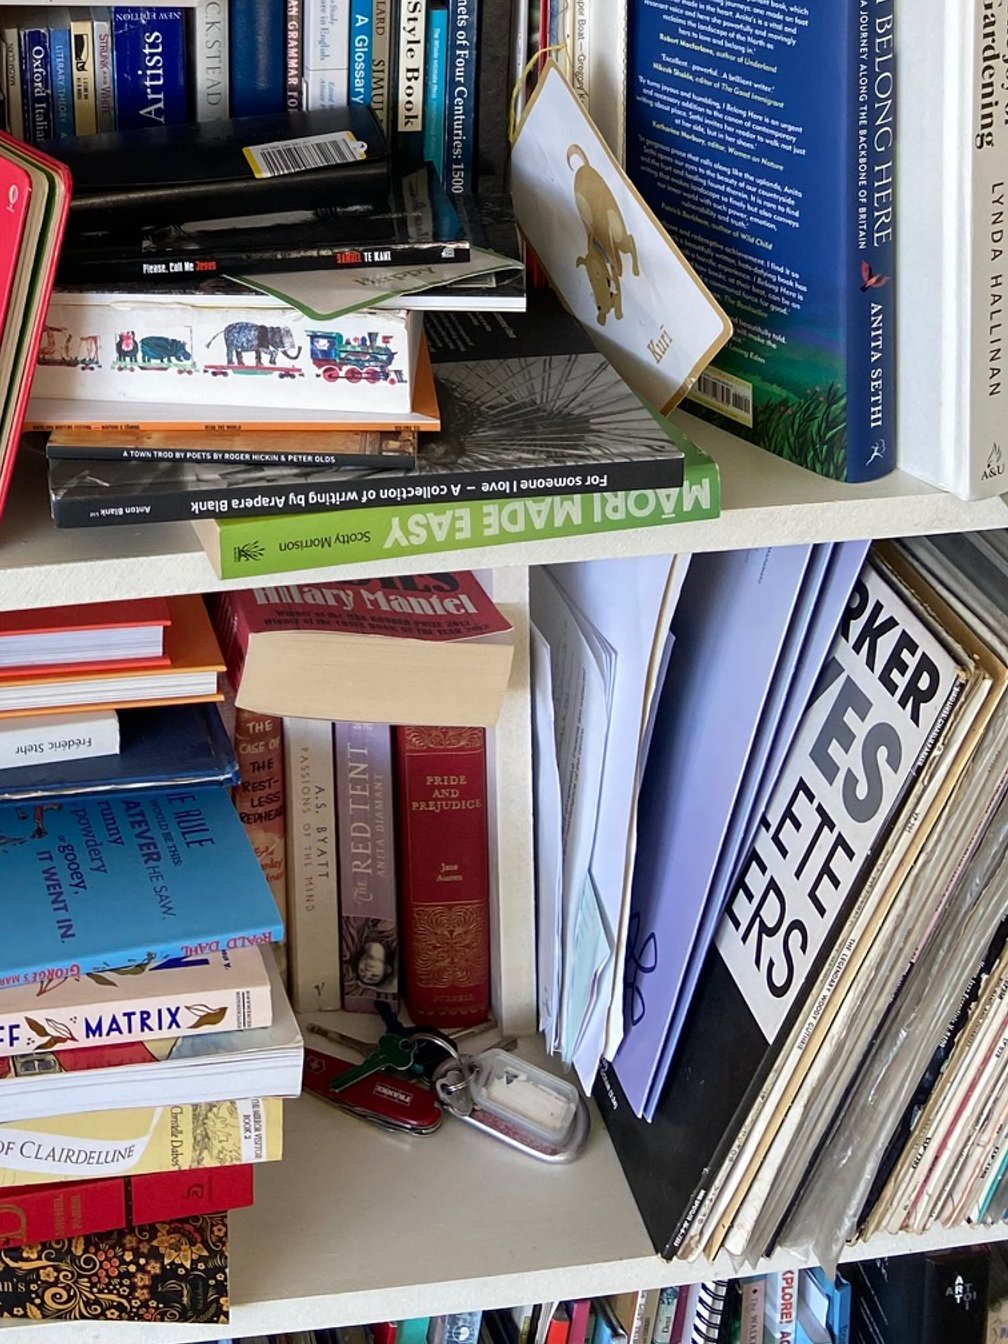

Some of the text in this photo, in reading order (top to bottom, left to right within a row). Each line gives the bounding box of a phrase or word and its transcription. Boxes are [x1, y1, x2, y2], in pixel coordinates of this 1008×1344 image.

[790, 3, 809, 16] which
[139, 32, 164, 124] Artists
[353, 35, 369, 104] Glossary
[404, 1, 421, 127] Style Book
[453, 86, 468, 159] Centuries:
[858, 11, 868, 249] JOURNEY BACKBONE BRITAIN
[874, 17, 893, 247] BELONG HERE
[451, 162, 465, 194] 1500
[990, 182, 1004, 397] LYNDA HALLINAN
[870, 302, 883, 427] ANITA SETHI
[191, 476, 584, 514] someone collection writing Arapera Blank
[279, 534, 332, 551] Morrison
[382, 501, 471, 548] EASY
[365, 590, 478, 615] Mantel
[426, 775, 467, 785] PRIDE
[348, 743, 373, 875] RED TENT
[412, 800, 481, 812] PREJUDICE
[84, 1006, 181, 1039] MATRIX
[797, 1022, 813, 1051] GUTHRIE
[19, 1142, 136, 1166] CLAIRDELUNE
